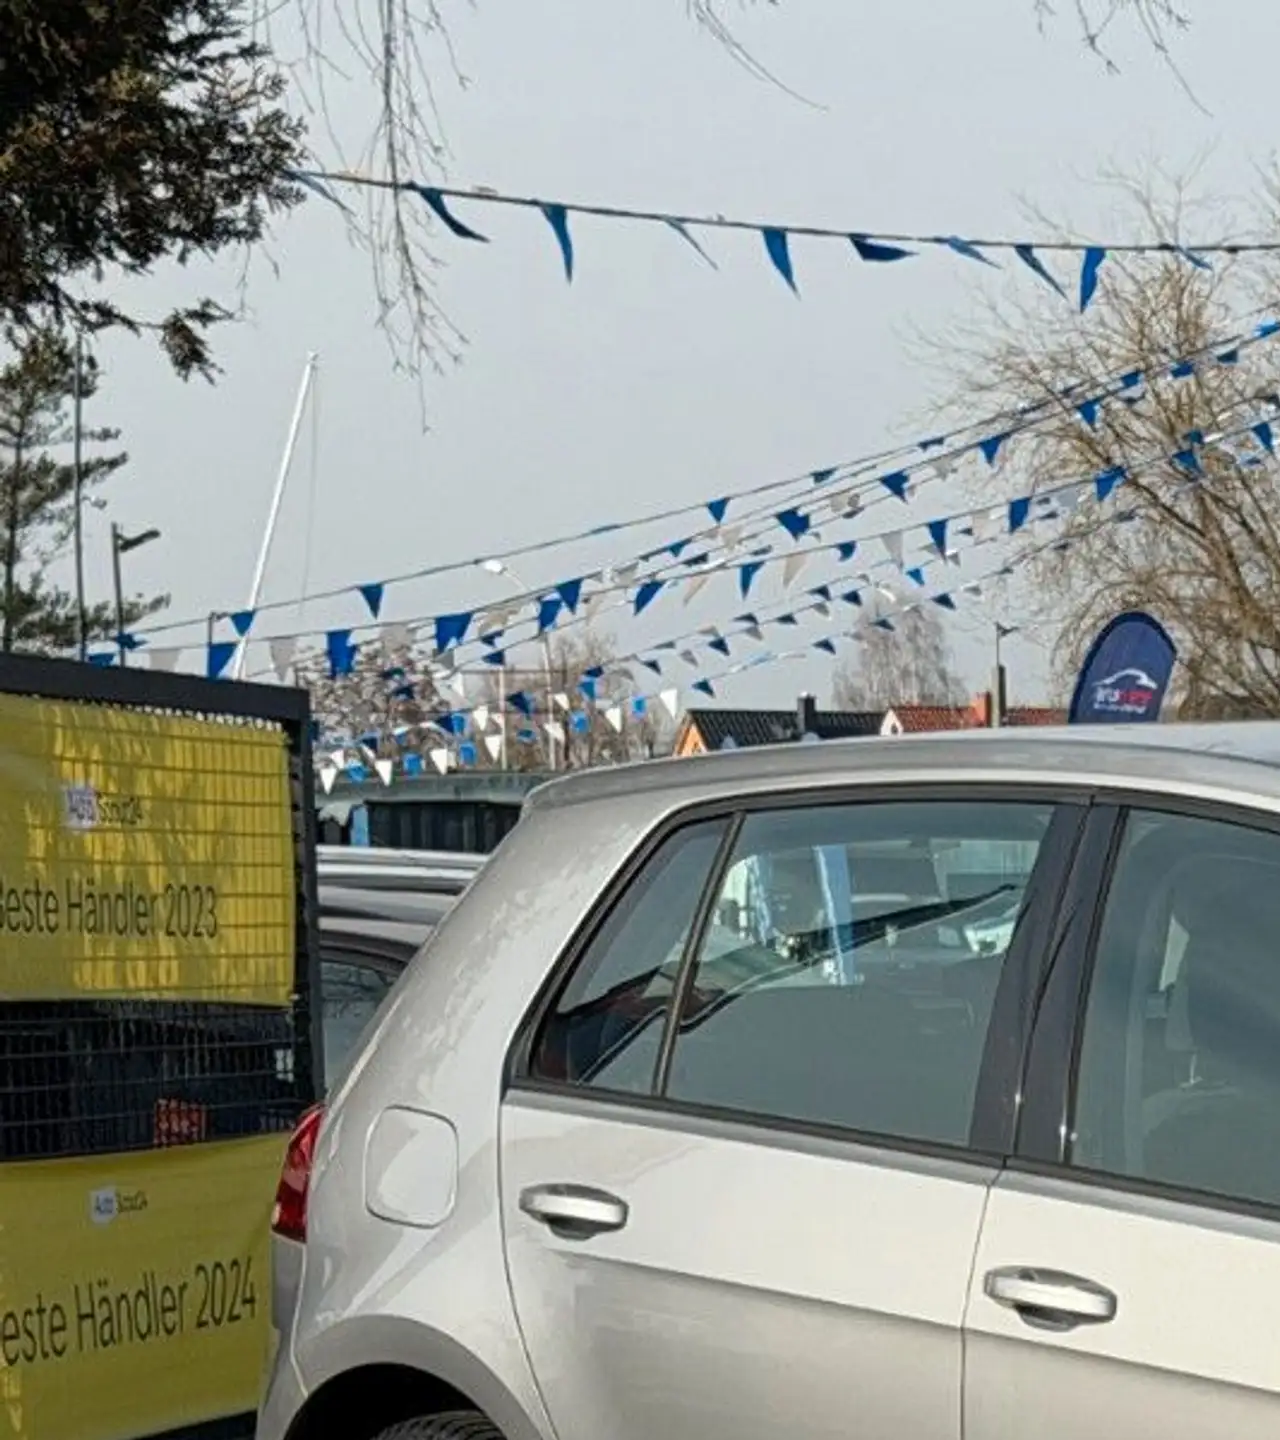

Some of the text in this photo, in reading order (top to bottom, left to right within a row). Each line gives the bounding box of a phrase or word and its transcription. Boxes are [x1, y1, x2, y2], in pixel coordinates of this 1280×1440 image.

[0, 877, 218, 938] este Händler 2023
[2, 1256, 257, 1367] este Händler 2024
